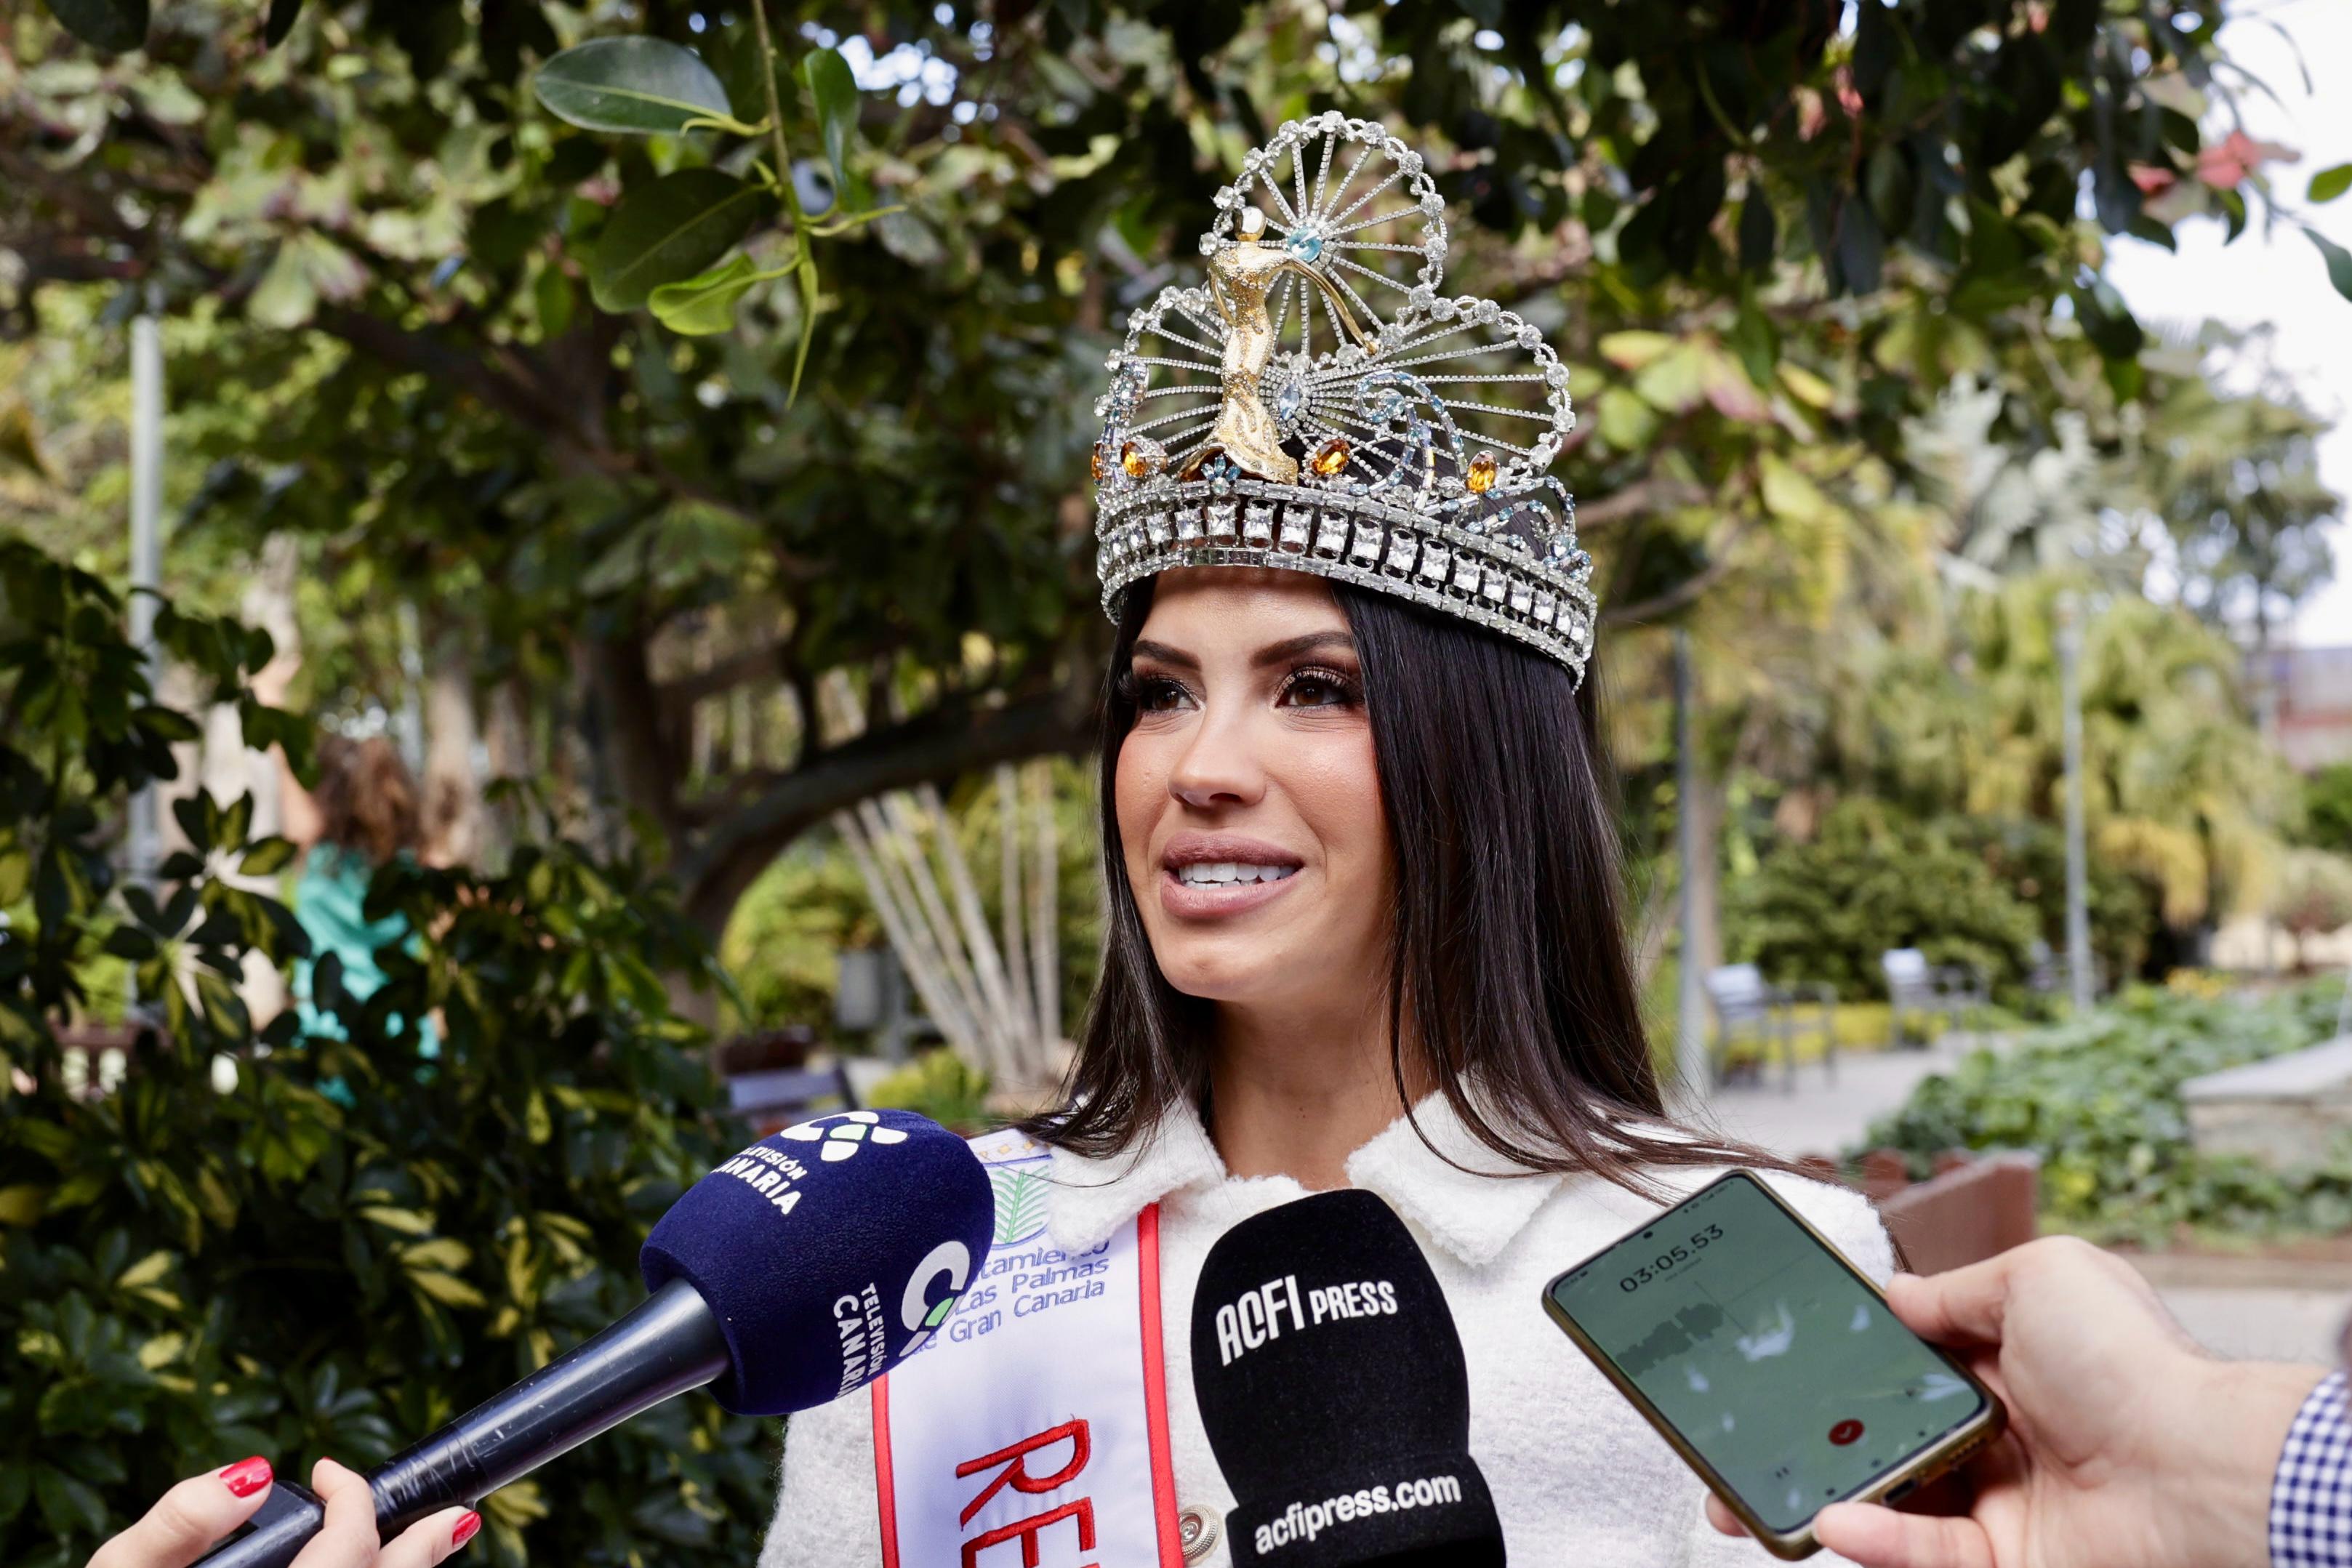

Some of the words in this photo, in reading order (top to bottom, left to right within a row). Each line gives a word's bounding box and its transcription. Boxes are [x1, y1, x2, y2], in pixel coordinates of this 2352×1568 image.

[710, 1157, 802, 1215] ANARIA
[1011, 1258, 1109, 1294] Palmas
[1619, 1223, 1724, 1293] 03:05.53
[861, 1282, 887, 1376] TELEVISIÓN
[950, 1309, 1002, 1343] Gran
[1014, 1279, 1106, 1318] Canaria
[1216, 1274, 1305, 1367] ACFI
[1309, 1280, 1398, 1325] PRESS
[955, 1418, 1100, 1568] RE
[1255, 1475, 1462, 1555] acfipress.com
